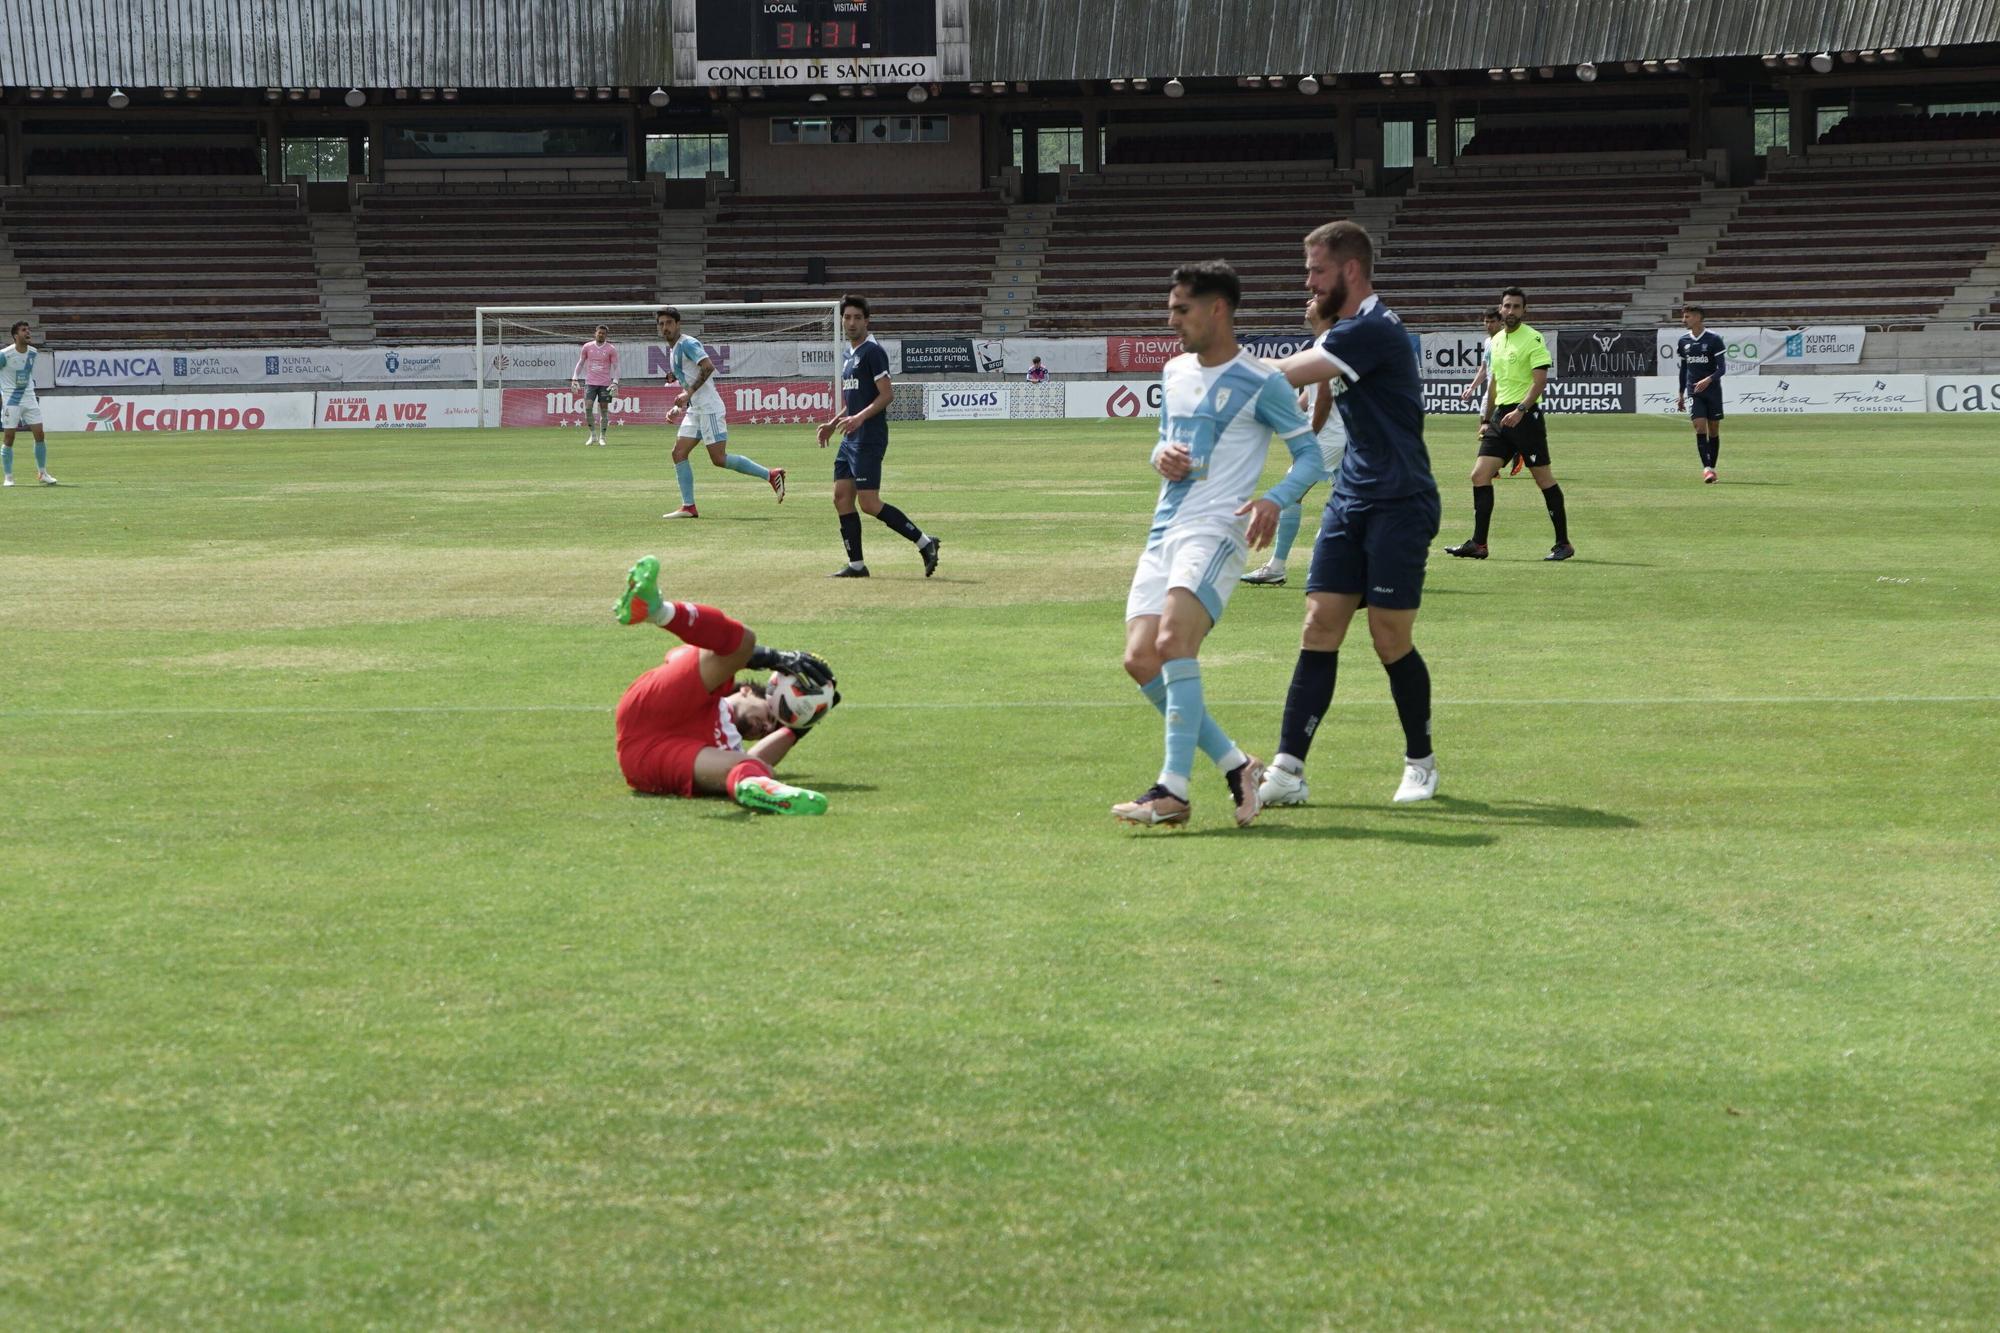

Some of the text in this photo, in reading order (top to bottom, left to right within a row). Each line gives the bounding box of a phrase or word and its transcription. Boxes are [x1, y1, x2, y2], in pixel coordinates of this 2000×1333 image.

[763, 4, 798, 13] LOCAL
[833, 2, 868, 12] VISITANTE
[707, 62, 926, 81] CONCELLO DE SANTIAGO
[1806, 334, 1837, 344] XUNTA
[906, 347, 924, 355] REAL
[1806, 344, 1855, 353] DE GALICIA
[190, 358, 220, 366] XUNTA
[282, 357, 312, 365] XUNTA
[512, 357, 556, 367] Xacobeo
[944, 353, 970, 361] FÚTBOL
[1134, 353, 1164, 364] döner
[1567, 351, 1646, 373] A VAQUIÑA
[190, 366, 239, 375] DE GALICIA
[282, 365, 331, 374] DE GALICIA
[735, 386, 833, 412] Mahou
[941, 391, 998, 408] SOUSAS
[1739, 390, 1828, 405] Frinsa
[1833, 390, 1923, 404] Frinsa
[1538, 397, 1622, 411] HYUPERSA
[85, 396, 265, 432] Alcampo
[324, 403, 428, 422] ALZA A VOZ
